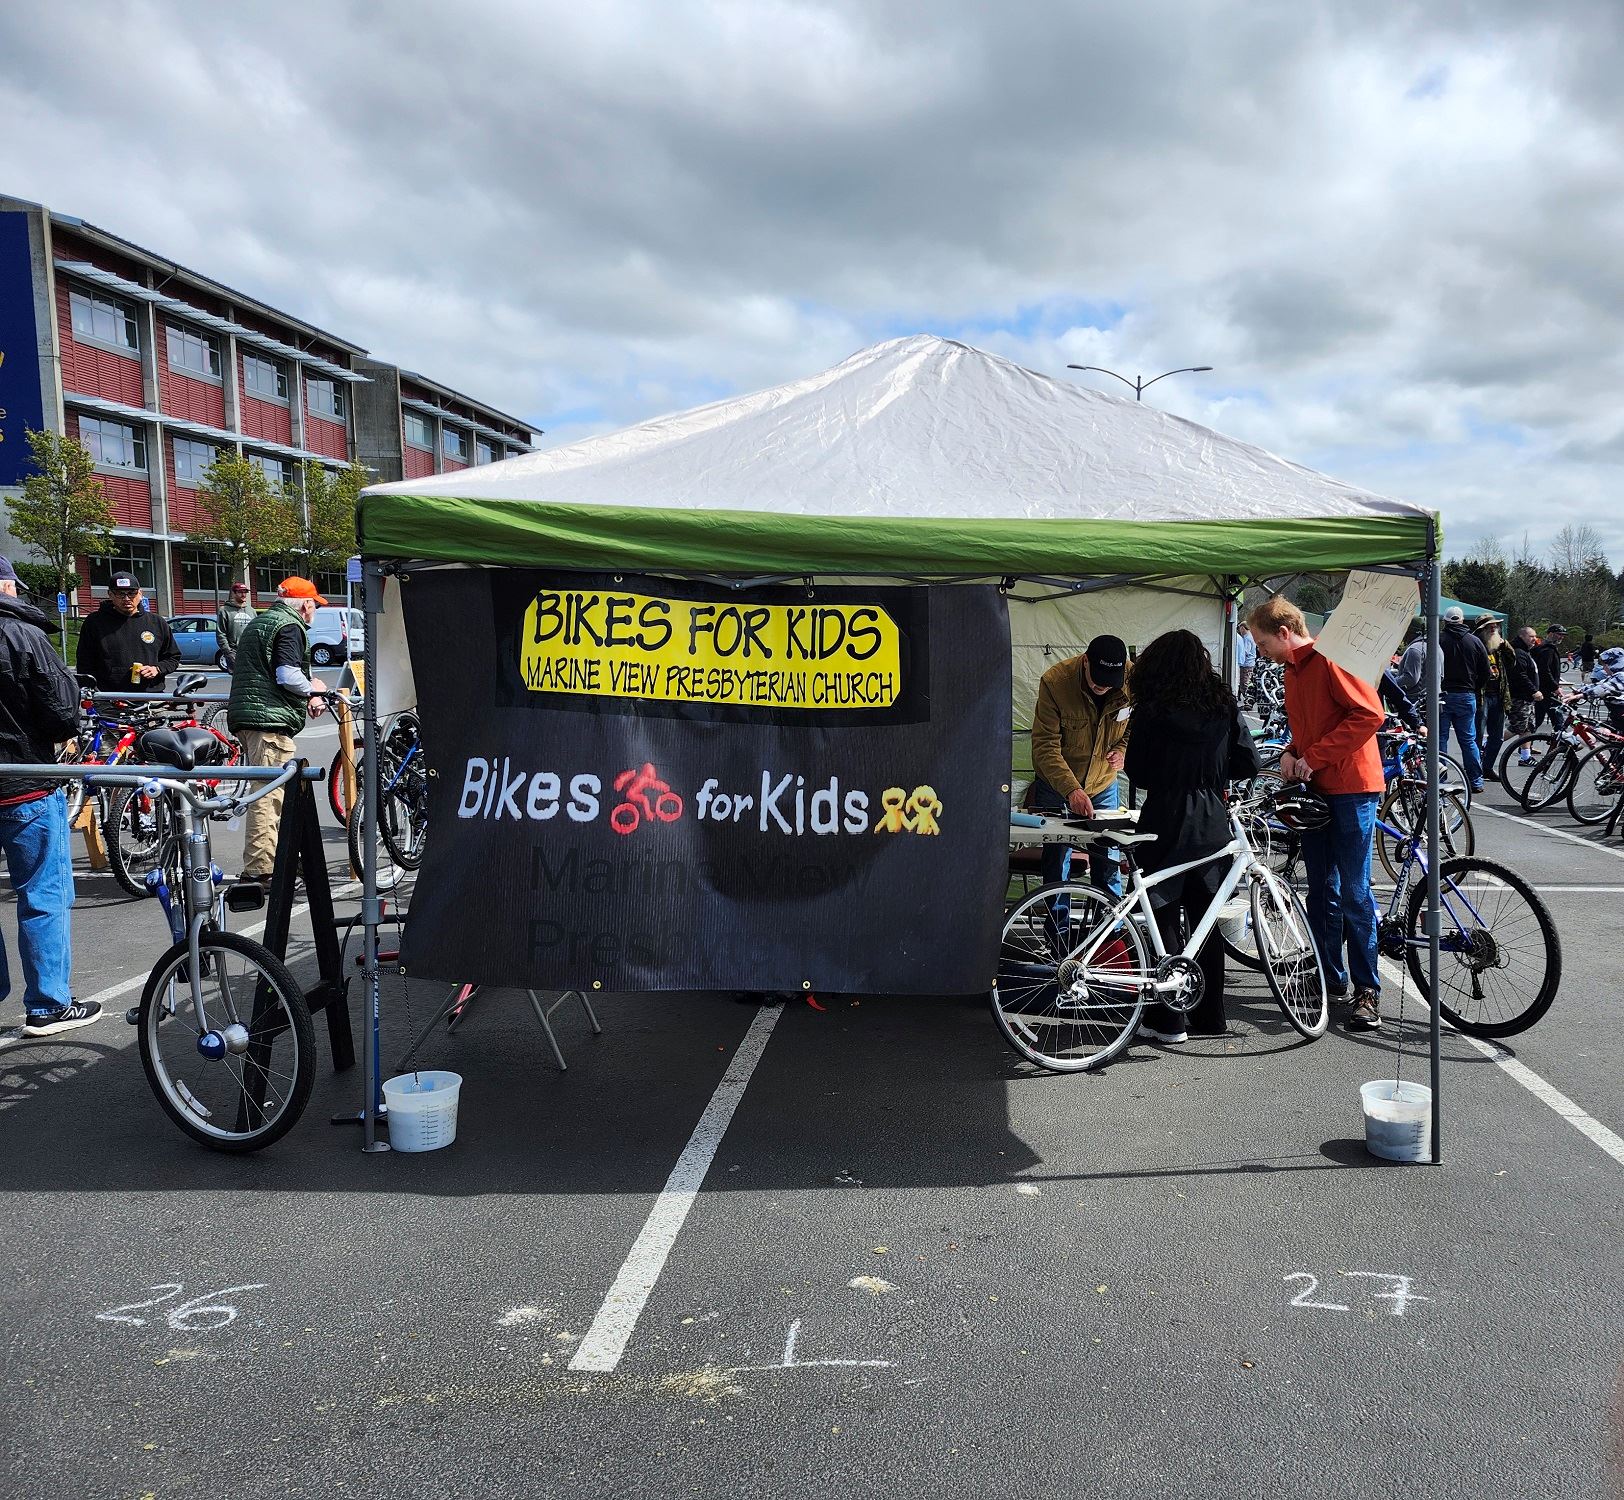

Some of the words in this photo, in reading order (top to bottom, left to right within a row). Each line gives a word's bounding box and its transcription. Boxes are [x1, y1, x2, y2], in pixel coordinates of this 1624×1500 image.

[534, 593, 673, 651] BIKES
[688, 606, 773, 659] FOR
[786, 607, 882, 660] KIDS
[527, 656, 601, 690] MARINE
[609, 660, 660, 695] VIEW
[665, 665, 806, 703] PRESBYTERIAN
[812, 672, 894, 704] CHURCH
[457, 756, 602, 823] Bikes
[695, 778, 754, 822] for
[759, 770, 869, 836] Kids
[531, 846, 722, 896] Marine
[95, 1283, 268, 1331] 26
[1282, 1270, 1432, 1317] 27
